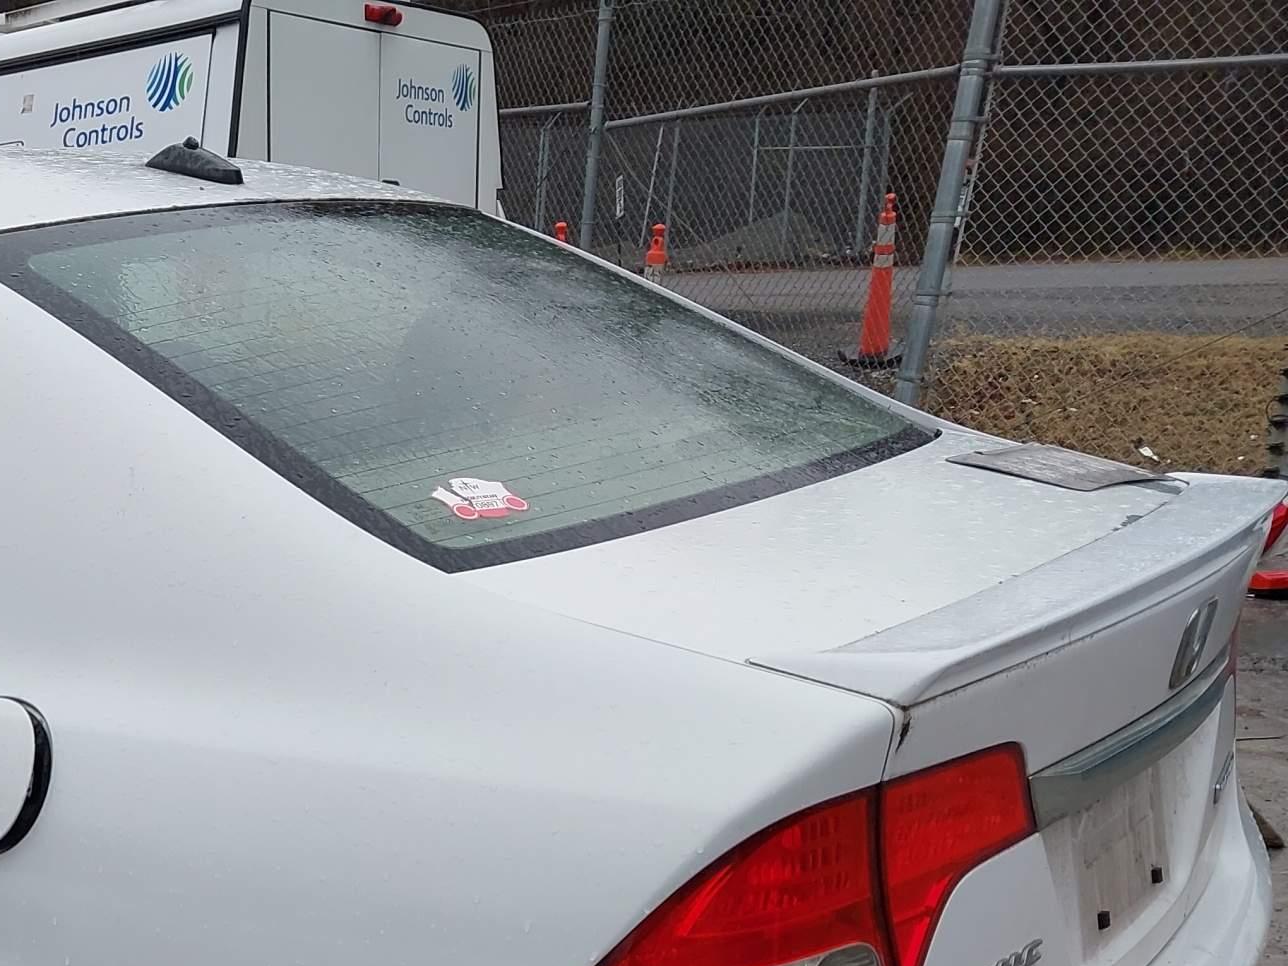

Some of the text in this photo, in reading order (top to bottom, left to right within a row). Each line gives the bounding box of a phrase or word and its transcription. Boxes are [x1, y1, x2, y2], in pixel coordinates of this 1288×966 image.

[396, 78, 445, 102] Johnson
[50, 96, 131, 127] Johnson
[405, 104, 453, 128] Controls
[63, 116, 144, 147] Controls
